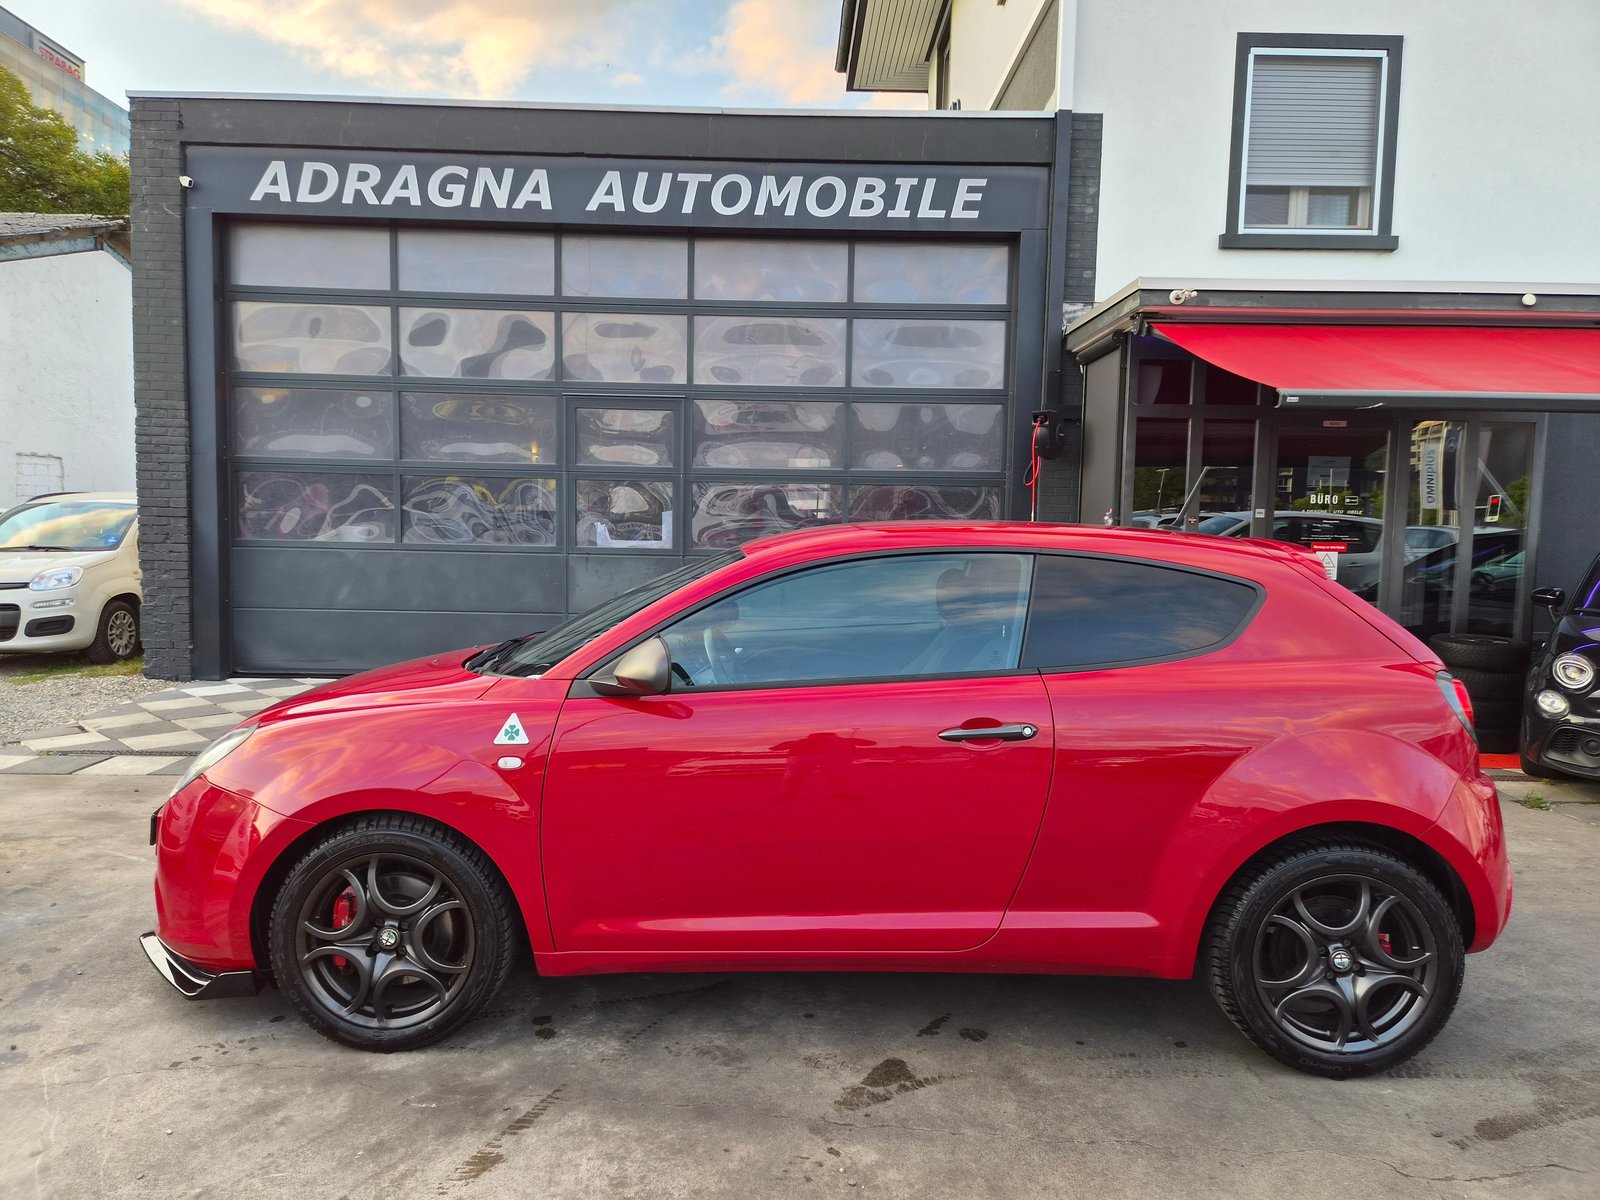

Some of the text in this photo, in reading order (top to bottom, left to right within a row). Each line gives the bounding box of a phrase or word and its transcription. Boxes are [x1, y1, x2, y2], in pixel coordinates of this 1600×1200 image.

[250, 161, 988, 219] ADRAGNA AUTOMOBILE
[1310, 493, 1338, 504] BÜRO
